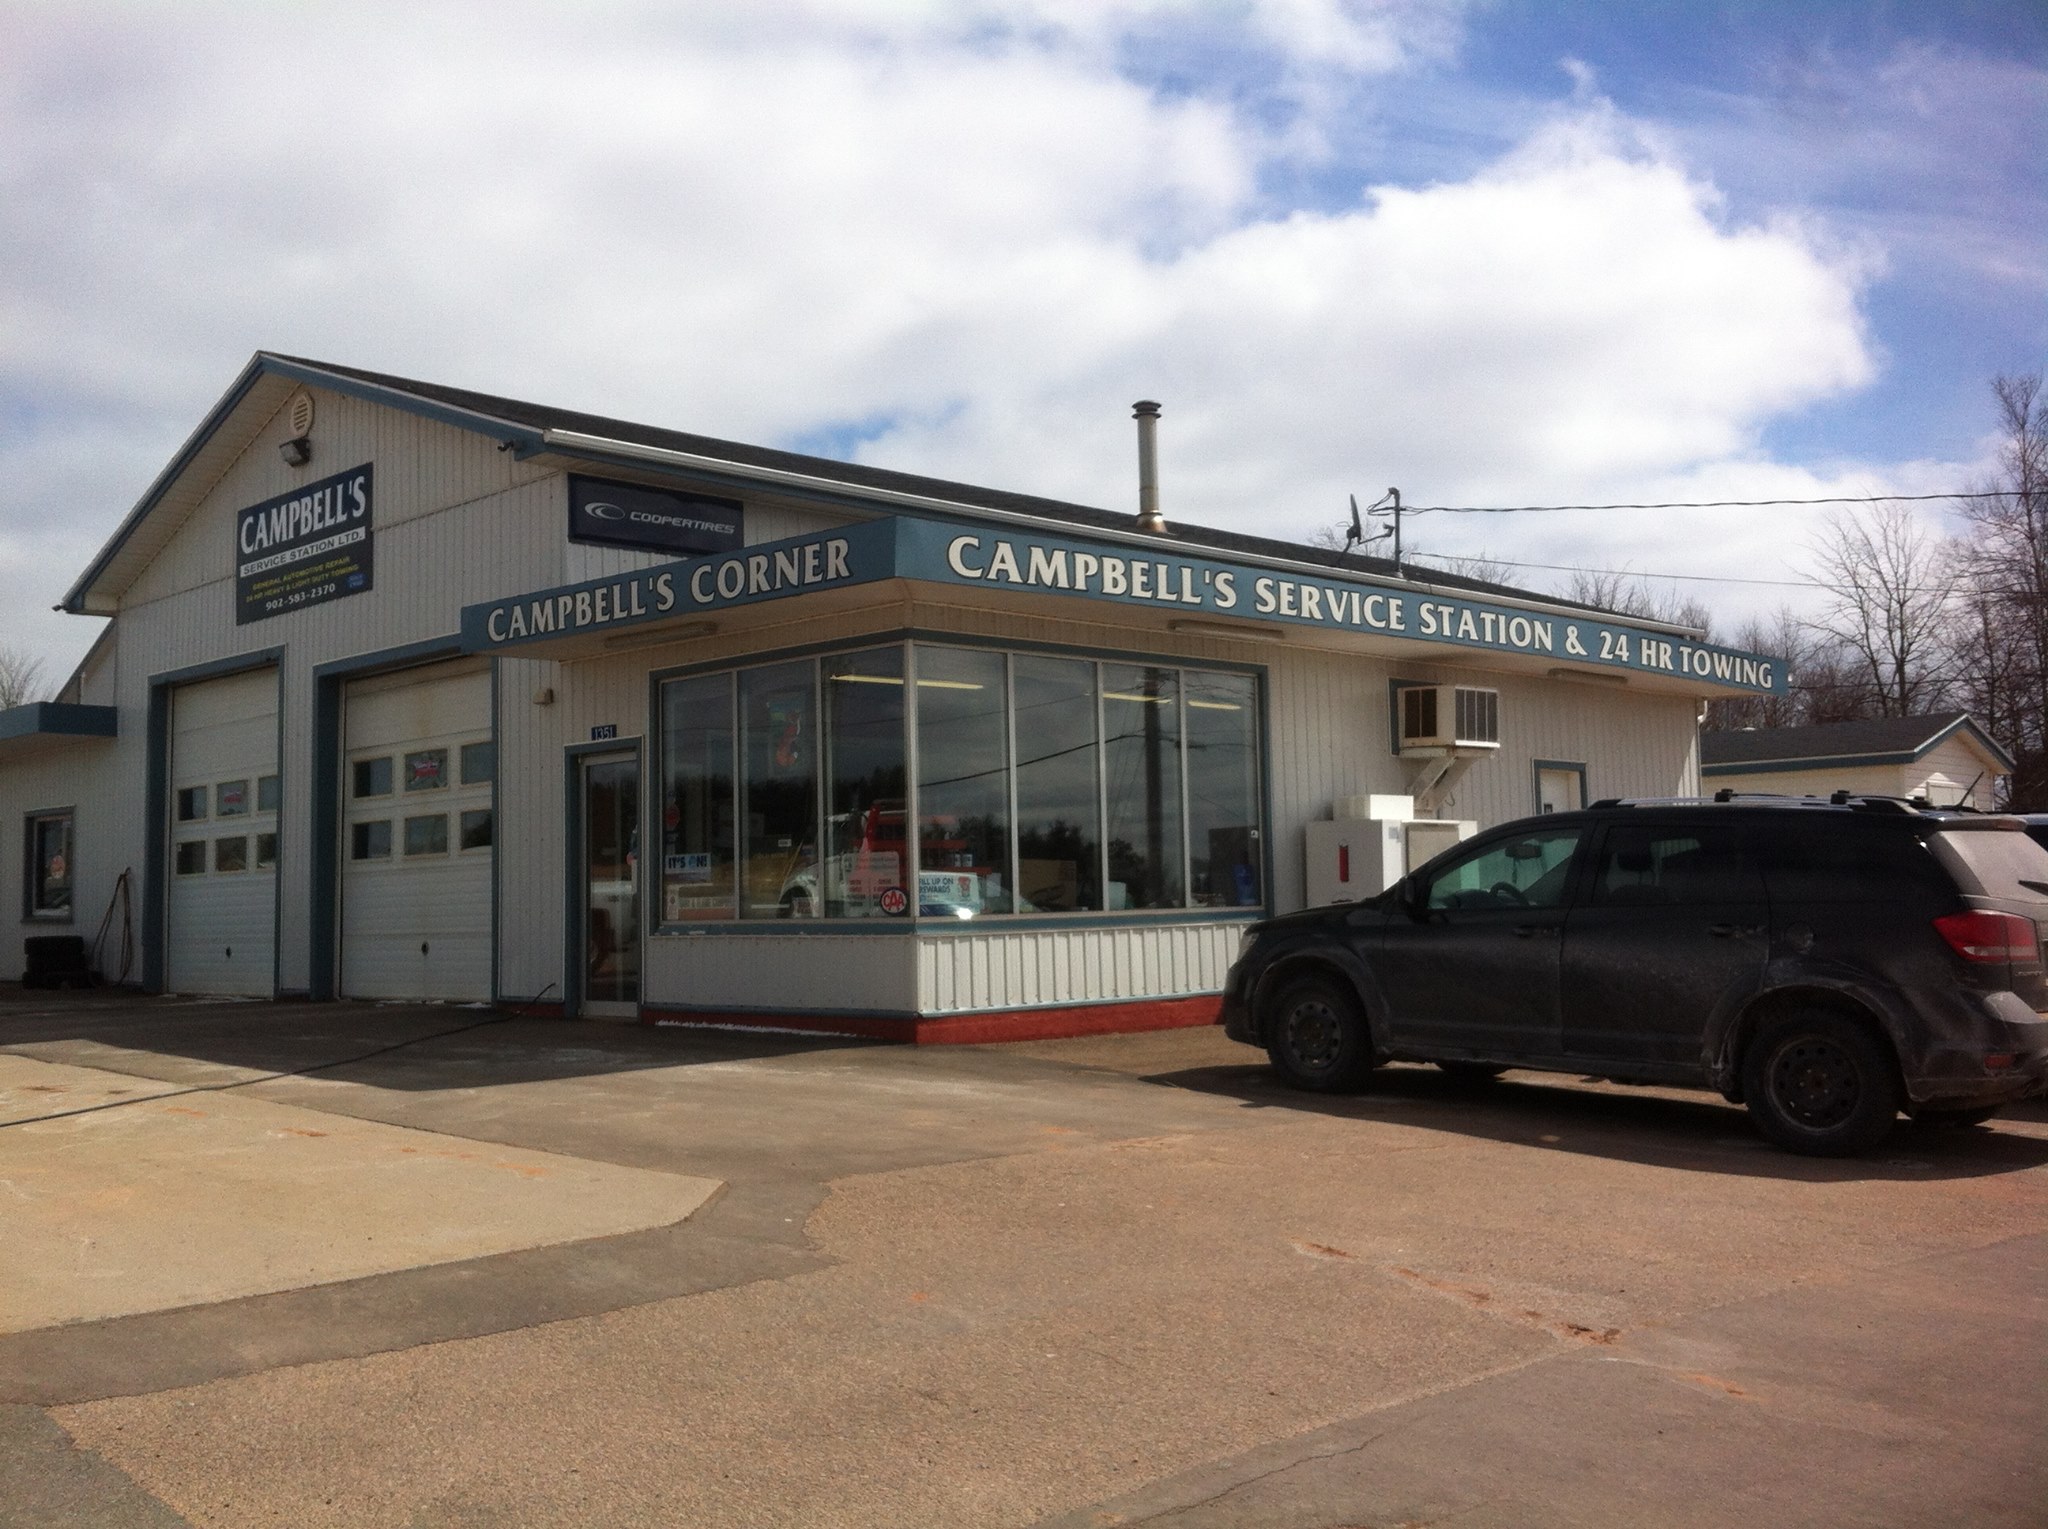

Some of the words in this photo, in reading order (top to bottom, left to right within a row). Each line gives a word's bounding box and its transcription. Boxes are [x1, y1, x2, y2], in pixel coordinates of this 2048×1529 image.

[240, 475, 366, 554] CAMPBELL'S
[630, 511, 735, 534] COOPERTIRES
[243, 552, 287, 576] SERVICE
[290, 539, 335, 561] STATION
[338, 530, 363, 546] LTD.
[265, 583, 336, 611] 902-583-2370
[487, 572, 675, 643] CAMPBELL'S
[691, 538, 851, 604] CORNER
[947, 535, 1238, 609] CAMPBELL'S
[1255, 576, 1406, 631] SERVICE
[1419, 602, 1553, 652] STATION
[1565, 625, 1588, 657] &
[1600, 630, 1629, 662] 24
[1641, 638, 1674, 671] HR
[1679, 646, 1773, 689] TOWING
[595, 726, 613, 741] 1351
[668, 857, 686, 869] IT'S
[932, 878, 941, 886] UP
[943, 877, 954, 885] ON
[884, 890, 905, 909] CAA
